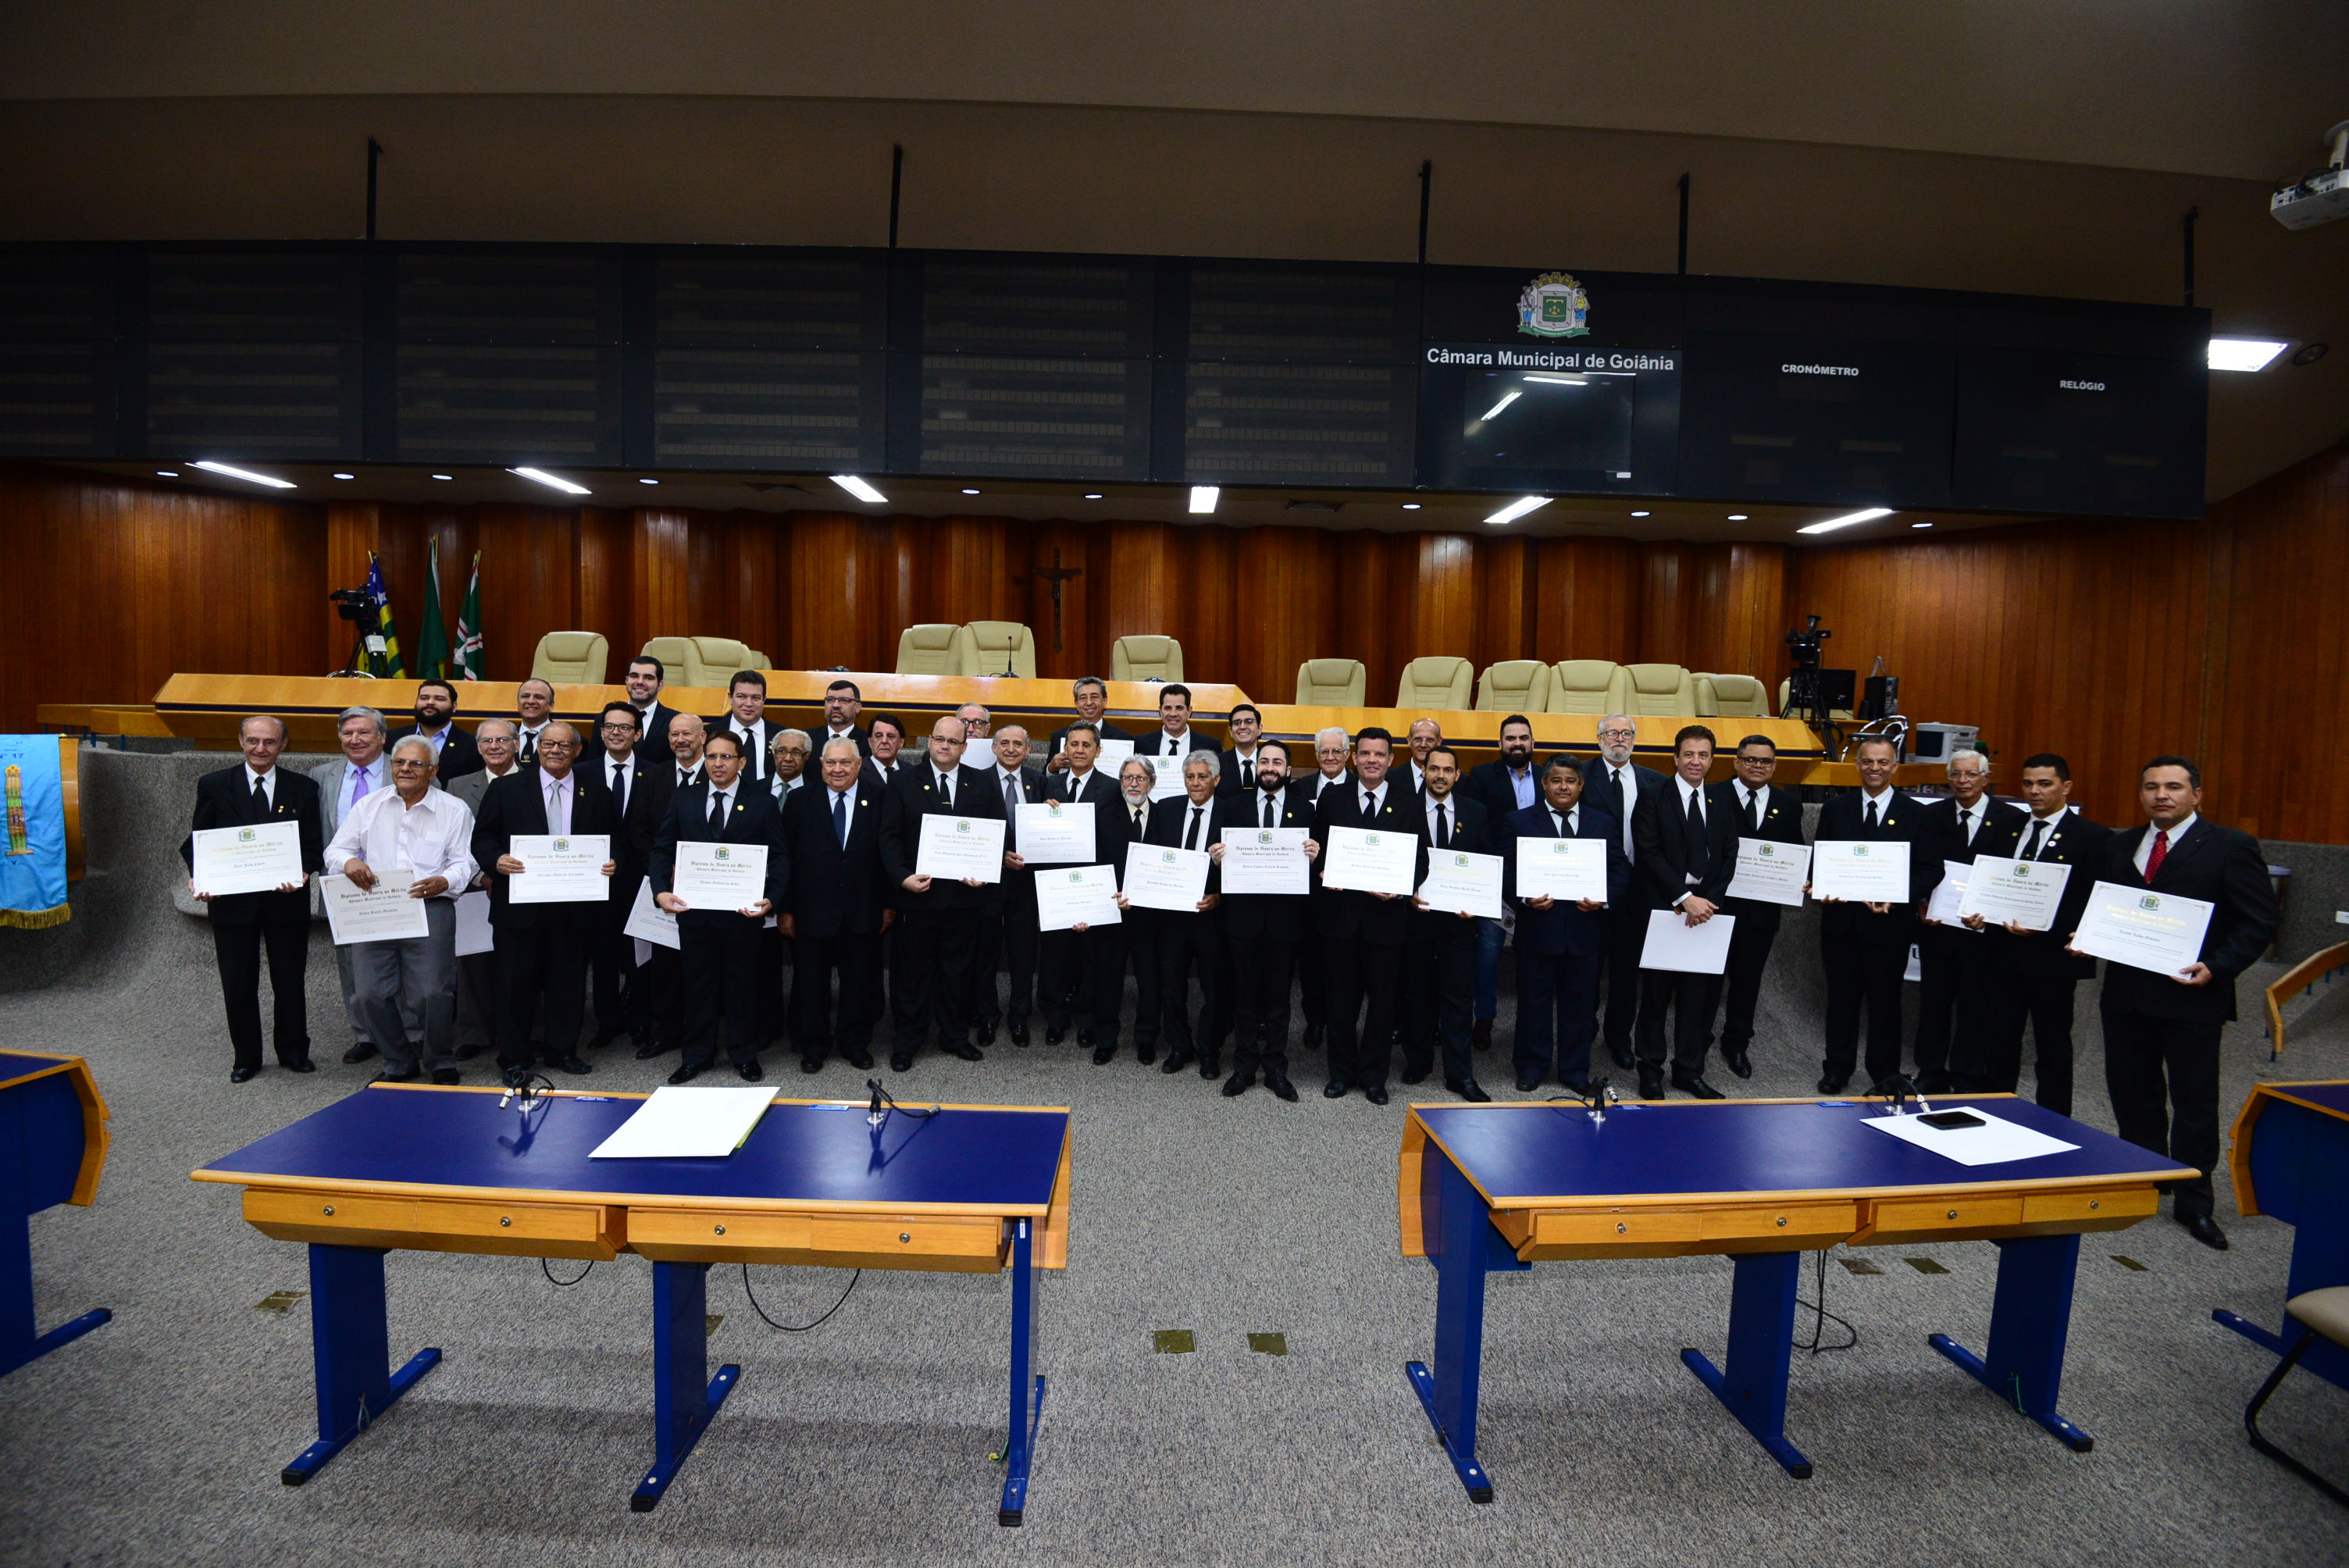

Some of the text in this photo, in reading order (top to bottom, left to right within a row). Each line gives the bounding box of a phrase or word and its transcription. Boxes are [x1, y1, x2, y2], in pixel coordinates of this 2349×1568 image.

[1427, 347, 1674, 370] Câmara Municipal de Goiânia
[1781, 364, 1859, 376] CRONÔMETRO
[2059, 380, 2105, 391] RELÓGIO
